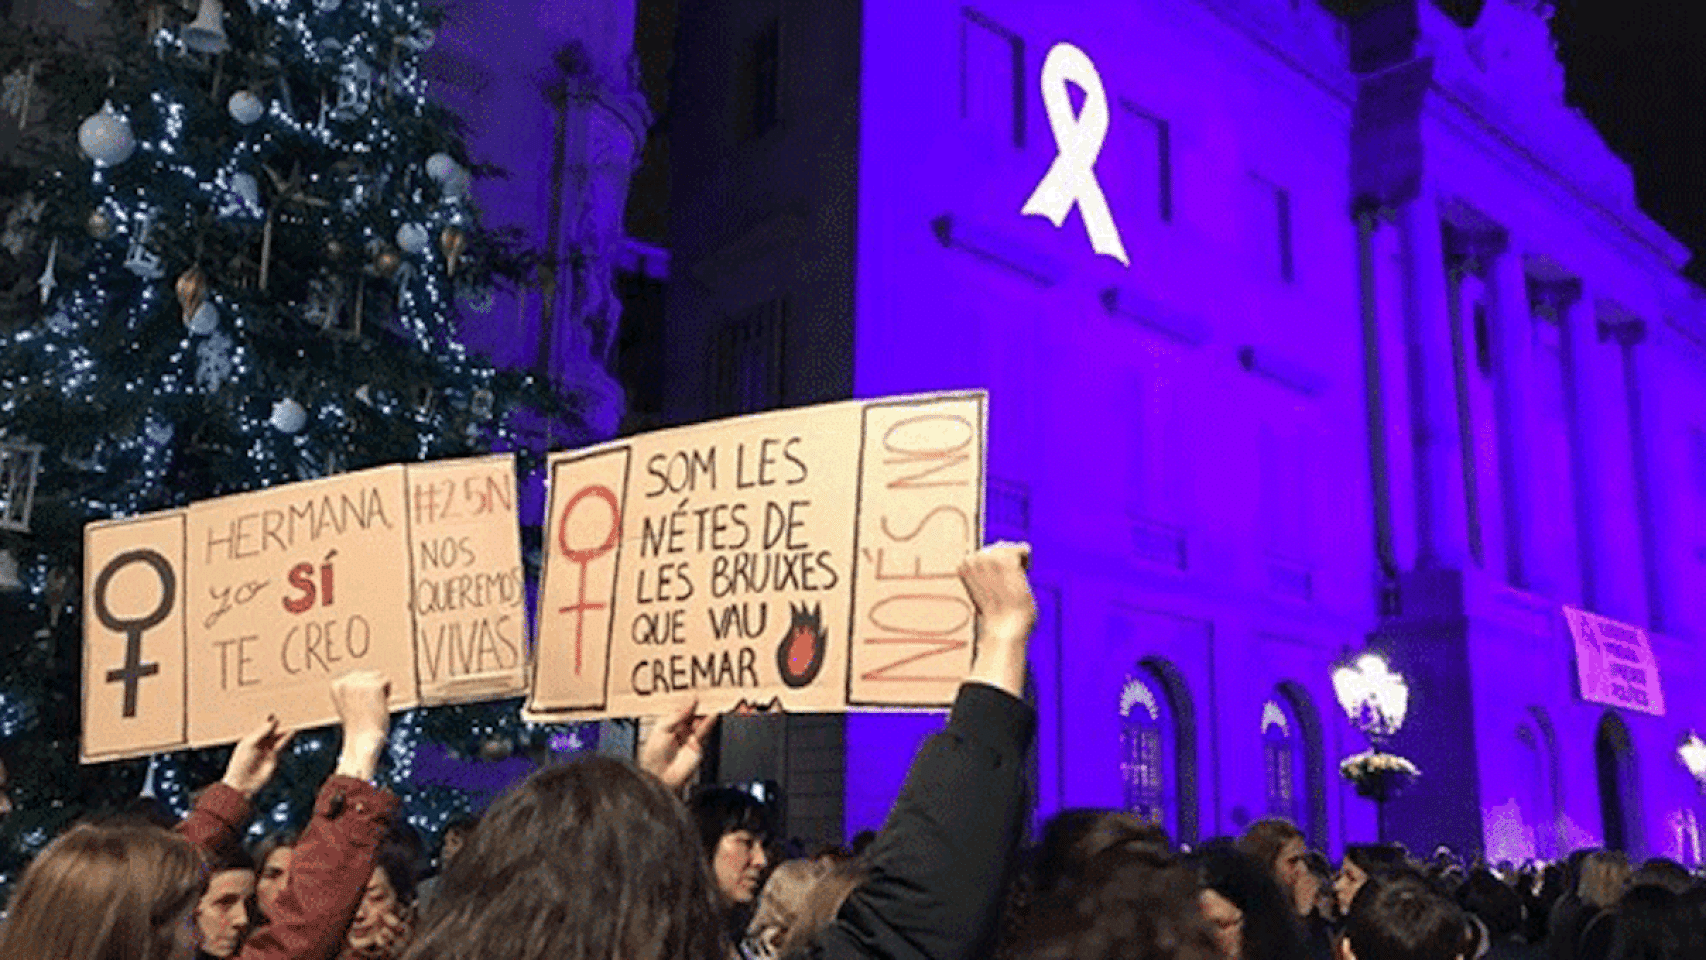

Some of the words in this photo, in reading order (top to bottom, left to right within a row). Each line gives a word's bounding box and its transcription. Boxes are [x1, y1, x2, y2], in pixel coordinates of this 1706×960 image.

[645, 445, 717, 498] SOM
[736, 437, 808, 489] LES
[882, 413, 974, 490] NO
[206, 487, 393, 564] HERMANA
[413, 473, 511, 524] #25N
[640, 498, 750, 558] NÉTES
[763, 500, 812, 551] DE
[420, 536, 476, 570] NOS
[863, 505, 970, 581] ÉS
[282, 549, 339, 614] SÍ
[418, 568, 522, 616] QUEREMOS
[636, 562, 694, 604] LES
[711, 550, 838, 598] BRUIXES
[212, 635, 260, 690] TE
[280, 614, 371, 675] CREO
[419, 614, 519, 682] VIVAS
[631, 610, 686, 645] QUE
[708, 602, 768, 641] VAU
[861, 593, 972, 682] NO
[631, 647, 759, 696] CREMAR
